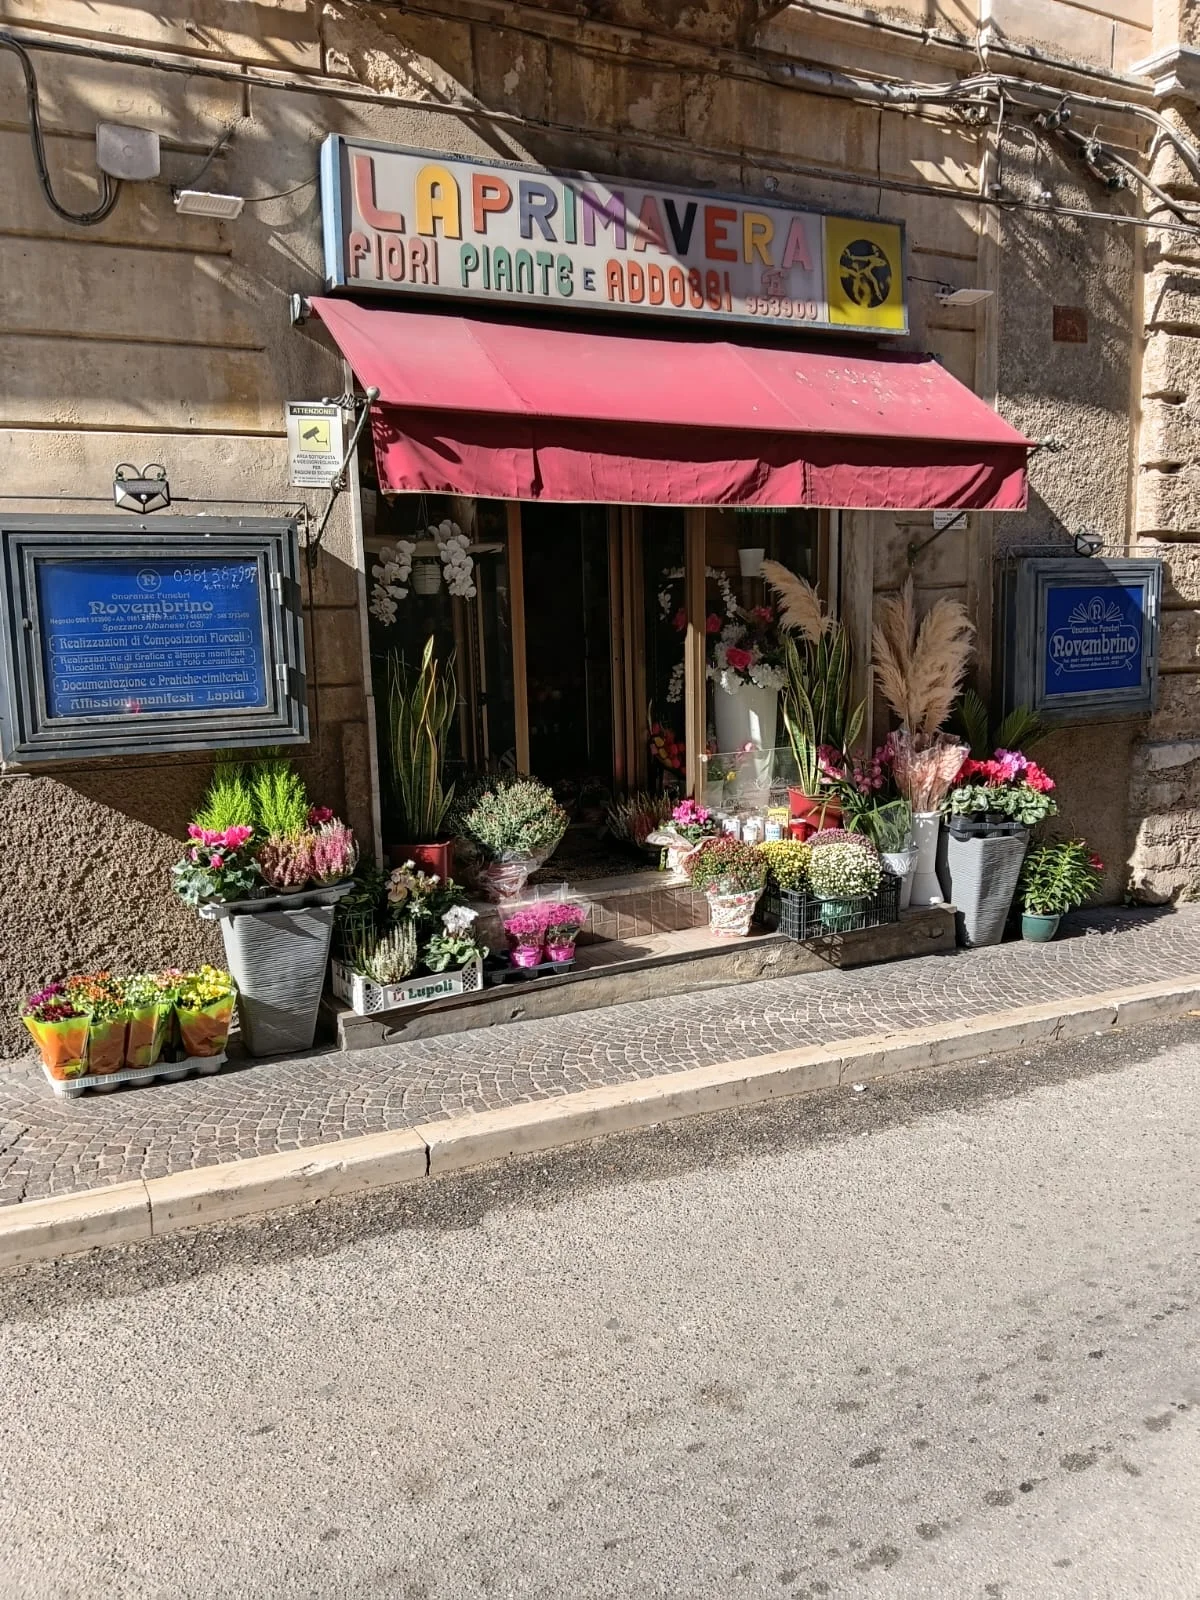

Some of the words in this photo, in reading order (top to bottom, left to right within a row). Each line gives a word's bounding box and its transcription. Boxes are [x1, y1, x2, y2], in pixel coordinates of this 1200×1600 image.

[350, 231, 439, 285] FIORI
[460, 242, 573, 297] PIANTE
[583, 267, 596, 291] E
[606, 258, 732, 313] ADDOBBI
[746, 296, 818, 321] 953900
[88, 600, 214, 615] Novembrino
[102, 623, 144, 633] Spezzano
[145, 622, 184, 630] Albanese
[186, 620, 205, 630] (CS)
[60, 636, 127, 649] Realizzazioni
[131, 635, 141, 646] di
[143, 633, 207, 647] Composizioni
[210, 631, 245, 643] Floreali
[1053, 633, 1137, 657] Novembrino
[60, 654, 122, 664] Realizzazione
[124, 652, 132, 661] di
[61, 677, 147, 692] Documentazione
[149, 677, 156, 687] e
[158, 673, 200, 687] Pratiche
[201, 670, 250, 684] cimiteriali
[70, 696, 132, 710] Affissioni
[136, 692, 194, 706] manifesti
[207, 690, 245, 702] Lapidi
[407, 979, 453, 999] Lupoli
